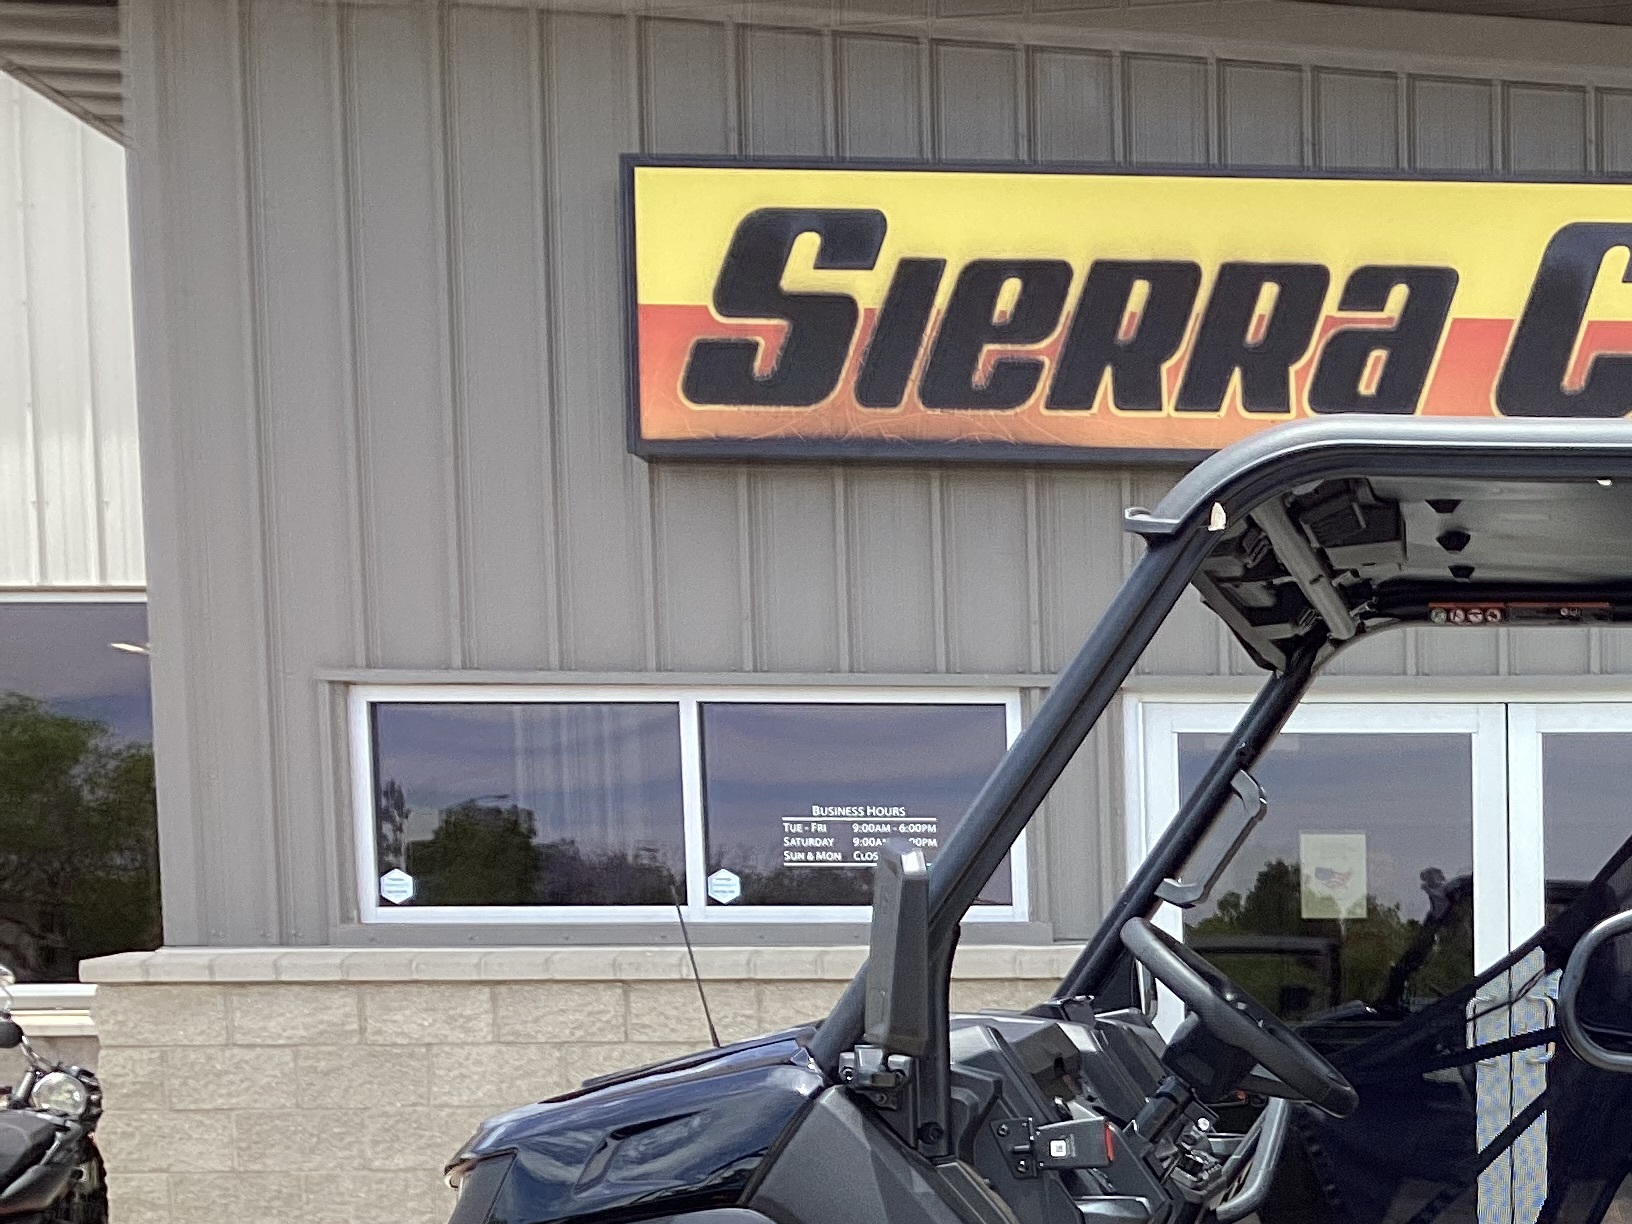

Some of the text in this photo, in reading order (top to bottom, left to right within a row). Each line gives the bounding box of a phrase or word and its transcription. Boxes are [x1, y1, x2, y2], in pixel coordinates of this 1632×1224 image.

[812, 805, 906, 817] BUSINESS HOURS
[783, 823, 803, 833] TUE
[811, 823, 827, 833] FRI
[852, 823, 891, 833] 9:00AM
[898, 823, 937, 833] 6:00PM
[783, 837, 834, 847] SATURDAY
[783, 851, 806, 862] SUN
[815, 851, 842, 862] MON
